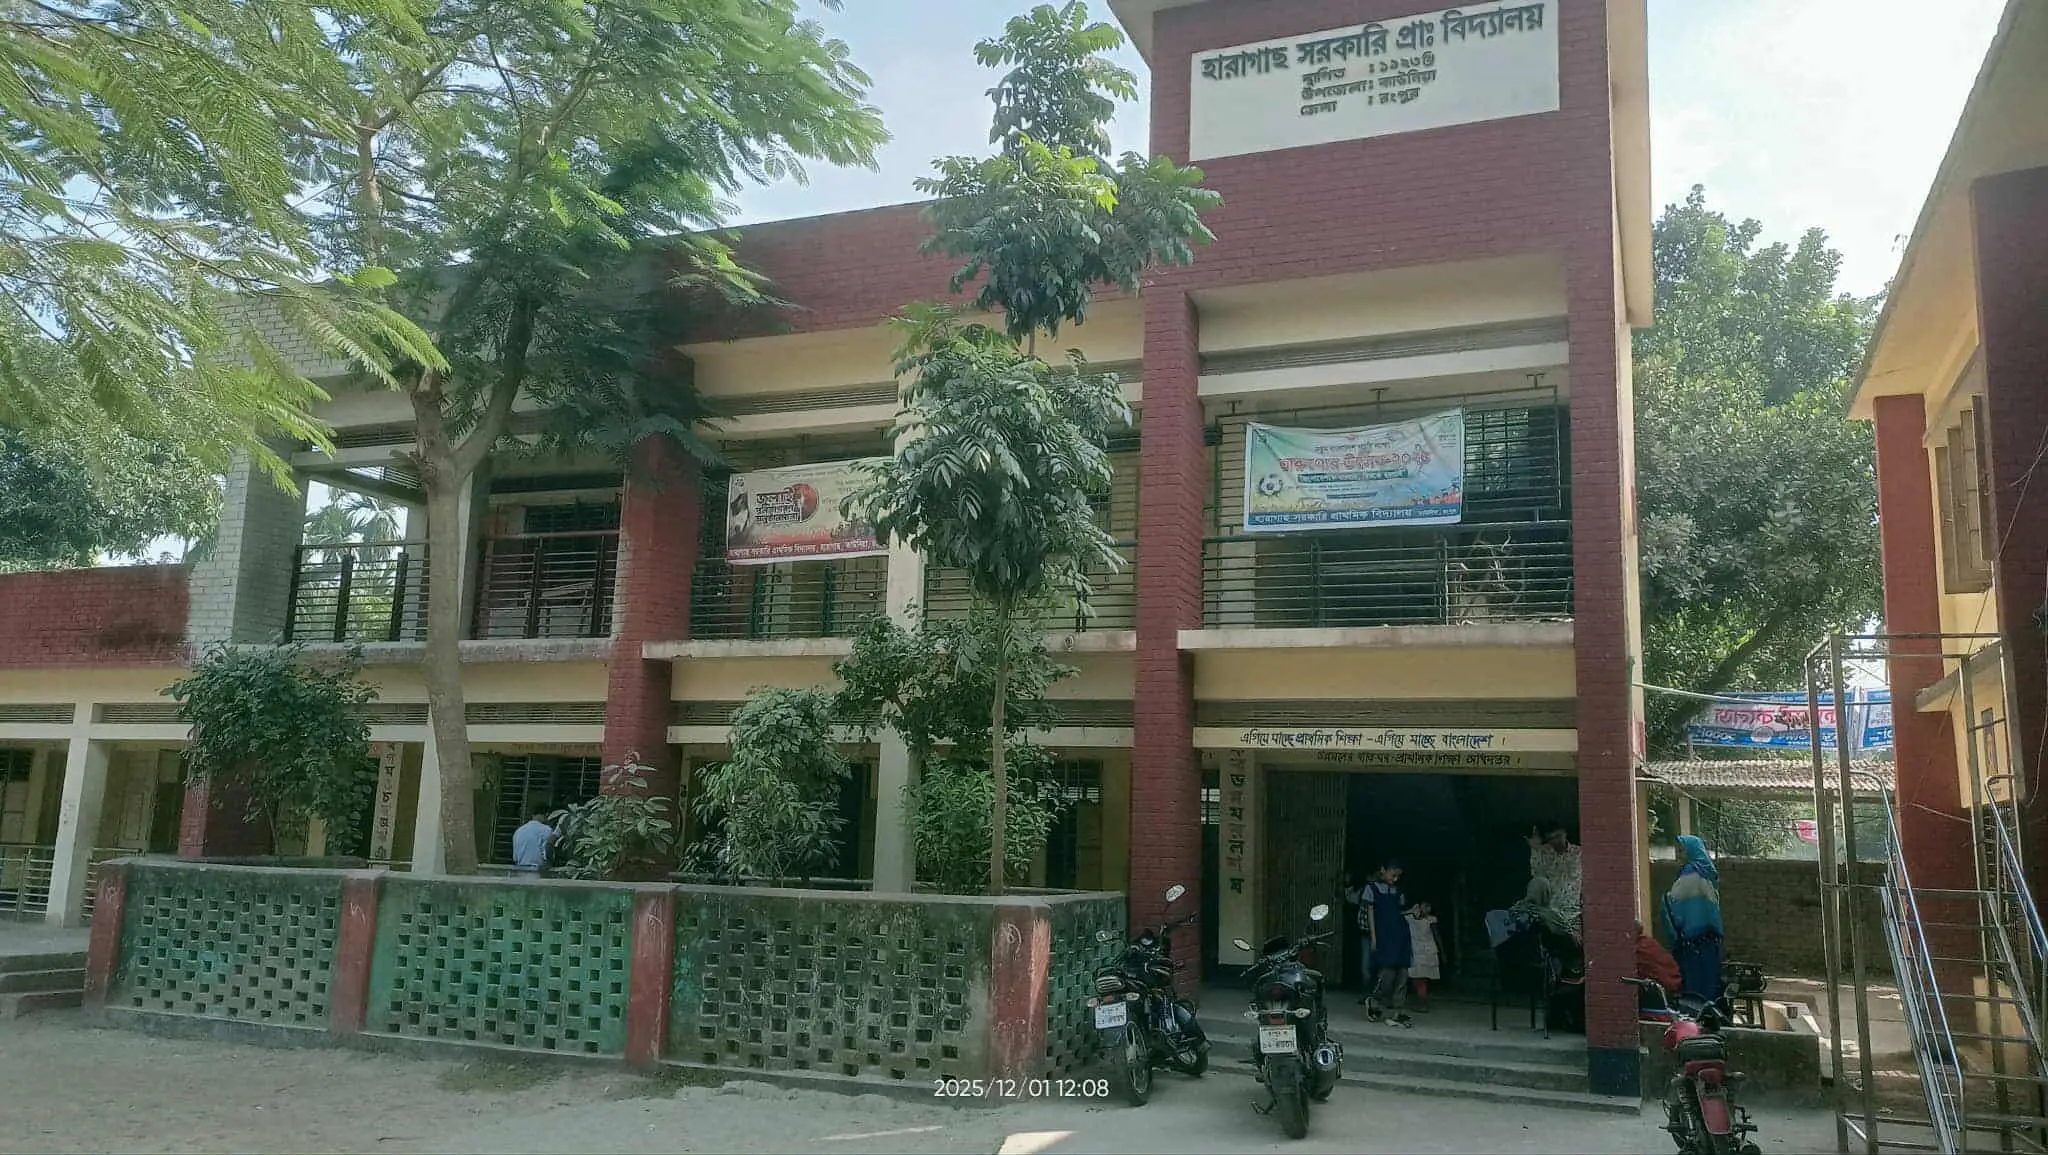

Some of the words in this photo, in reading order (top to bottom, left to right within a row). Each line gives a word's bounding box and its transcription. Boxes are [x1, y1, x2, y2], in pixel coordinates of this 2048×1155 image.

[1201, 46, 1289, 80] হারাগাছ
[1297, 24, 1389, 65] সরকারি
[1440, 3, 1545, 45] বিদ্যালয়
[1301, 101, 1338, 116] জেলা
[1378, 87, 1421, 104] রংপুর
[1240, 729, 1269, 746] এগিয়ে
[1295, 729, 1334, 746] প্রাথমিক
[1335, 729, 1362, 746] শিক্ষা
[1410, 732, 1437, 749] যাচ্ছে
[1442, 732, 1494, 749] বাংলাদেশ
